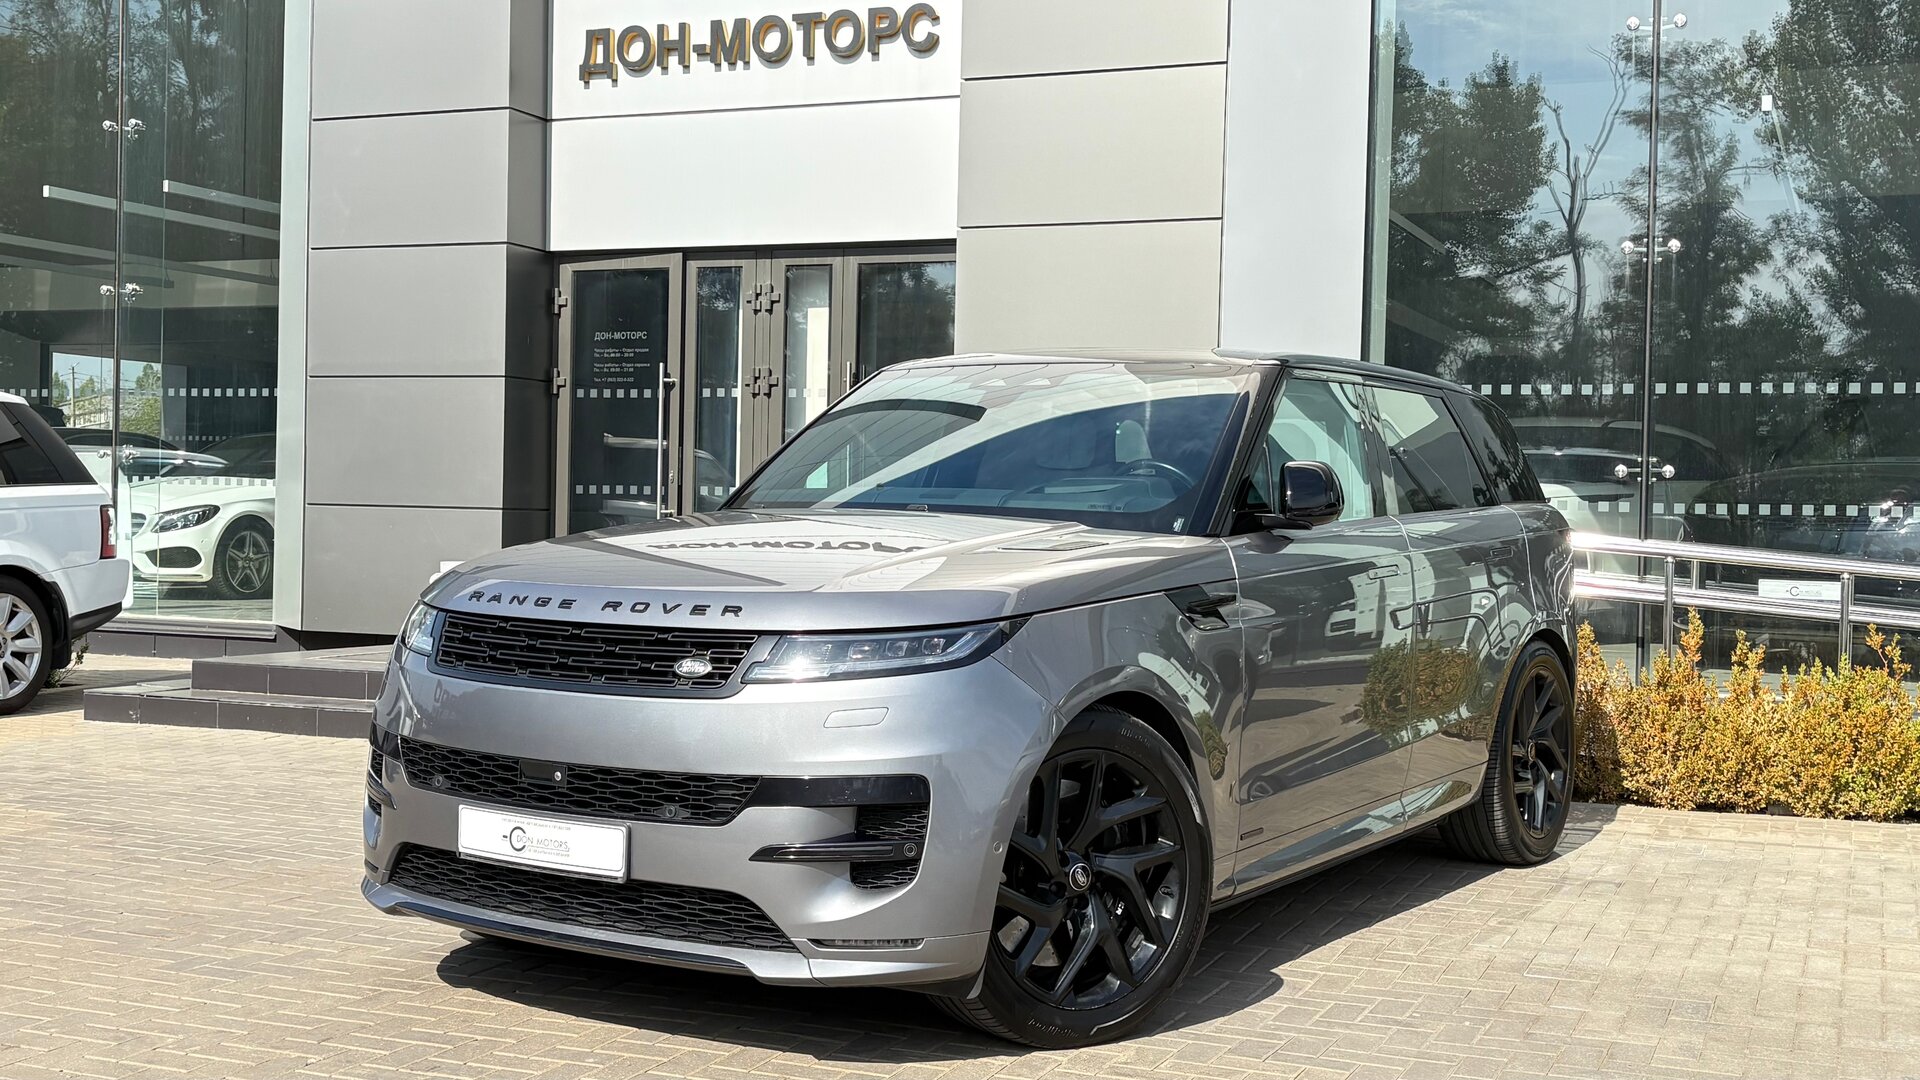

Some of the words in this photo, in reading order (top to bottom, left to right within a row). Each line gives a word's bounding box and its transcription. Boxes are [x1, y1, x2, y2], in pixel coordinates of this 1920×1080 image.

[579, 3, 940, 83] ДОН-МОТОРС
[594, 331, 648, 341] ДОН-МОТОРС
[468, 591, 577, 610] RANGE
[600, 602, 743, 617] ROVER
[517, 835, 533, 845] DON
[537, 839, 568, 849] MOTORS
